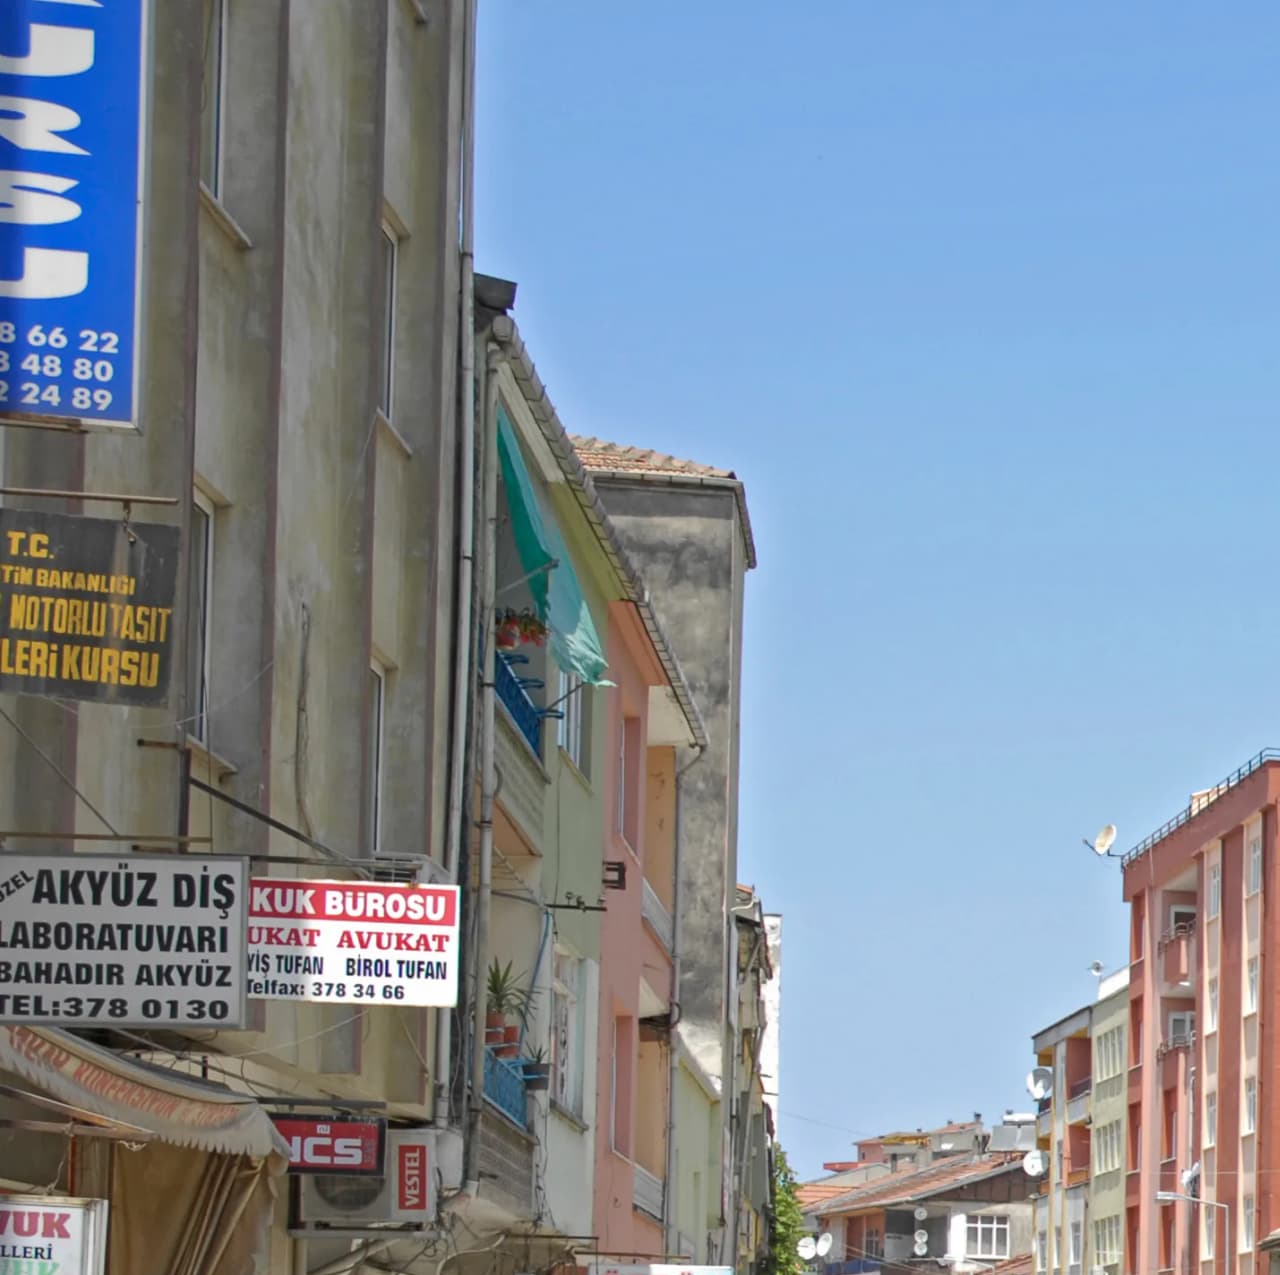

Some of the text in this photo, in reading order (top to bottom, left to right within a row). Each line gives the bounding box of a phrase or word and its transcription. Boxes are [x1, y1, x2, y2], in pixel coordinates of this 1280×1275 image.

[27, 324, 68, 349] 66
[79, 328, 120, 354] 22
[21, 352, 62, 377] 48
[73, 357, 114, 382] 80
[20, 382, 61, 406] 24
[72, 386, 113, 411] 89
[7, 531, 55, 559] T.C.
[9, 594, 172, 643] MOTORLU TAŞIT
[62, 644, 159, 687] KURSU
[32, 862, 158, 907] AKYÜZ
[173, 865, 236, 919] DİŞ
[249, 886, 446, 921] KUK BÜROSU
[336, 931, 449, 952] AVUKAT
[0, 959, 232, 987] BAHADIR AKYÜZ
[276, 954, 324, 975] TUFAN
[346, 954, 391, 977] BİROL
[397, 960, 447, 980] TUFAN
[312, 982, 346, 998] 378
[353, 984, 375, 999] 34
[382, 985, 405, 1000] 66
[141, 999, 229, 1020] 0130
[404, 1147, 420, 1207] VESTEL
